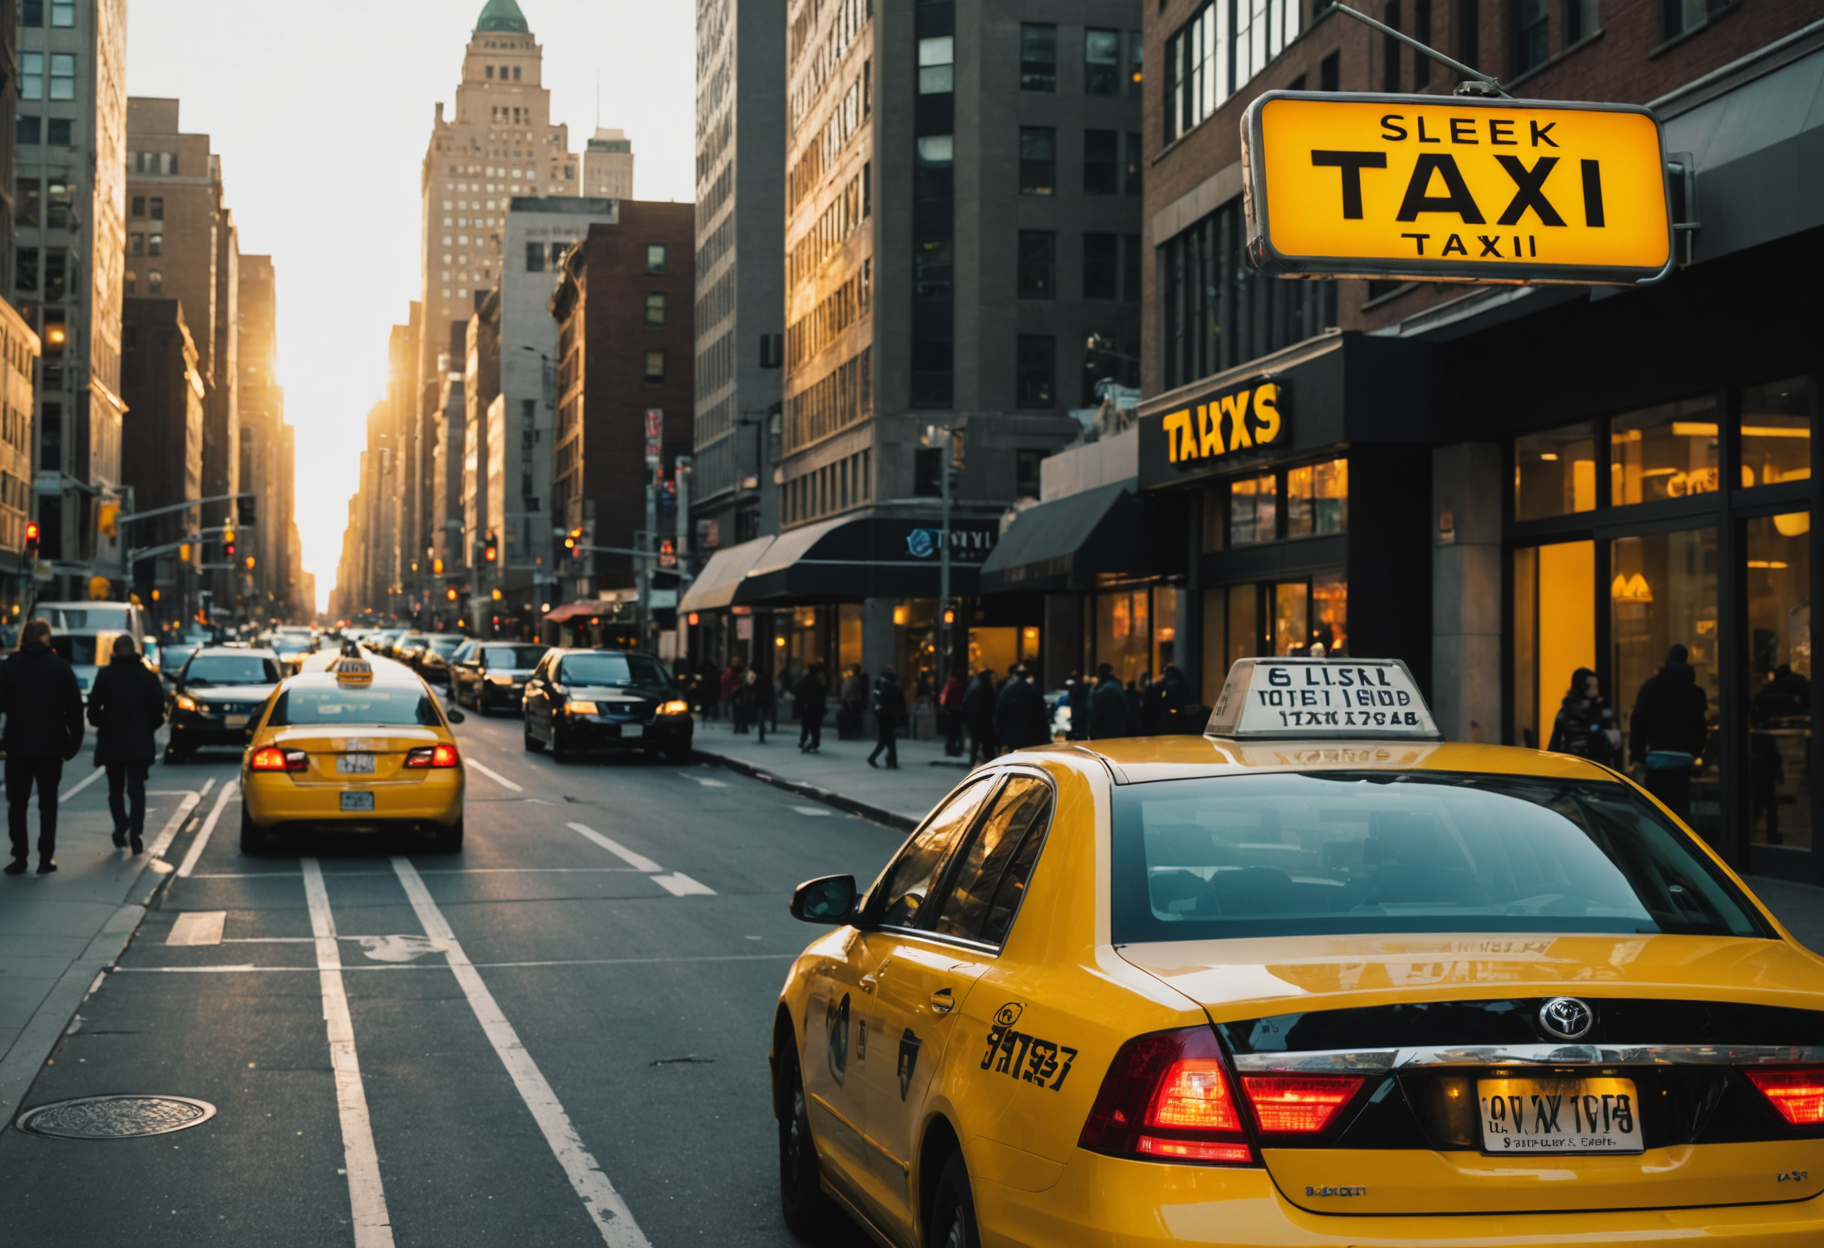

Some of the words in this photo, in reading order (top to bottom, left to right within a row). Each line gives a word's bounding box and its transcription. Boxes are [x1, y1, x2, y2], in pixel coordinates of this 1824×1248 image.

[1380, 114, 1560, 147] SLEEK
[1311, 149, 1605, 228] TAXI
[1401, 233, 1537, 258] TAXII
